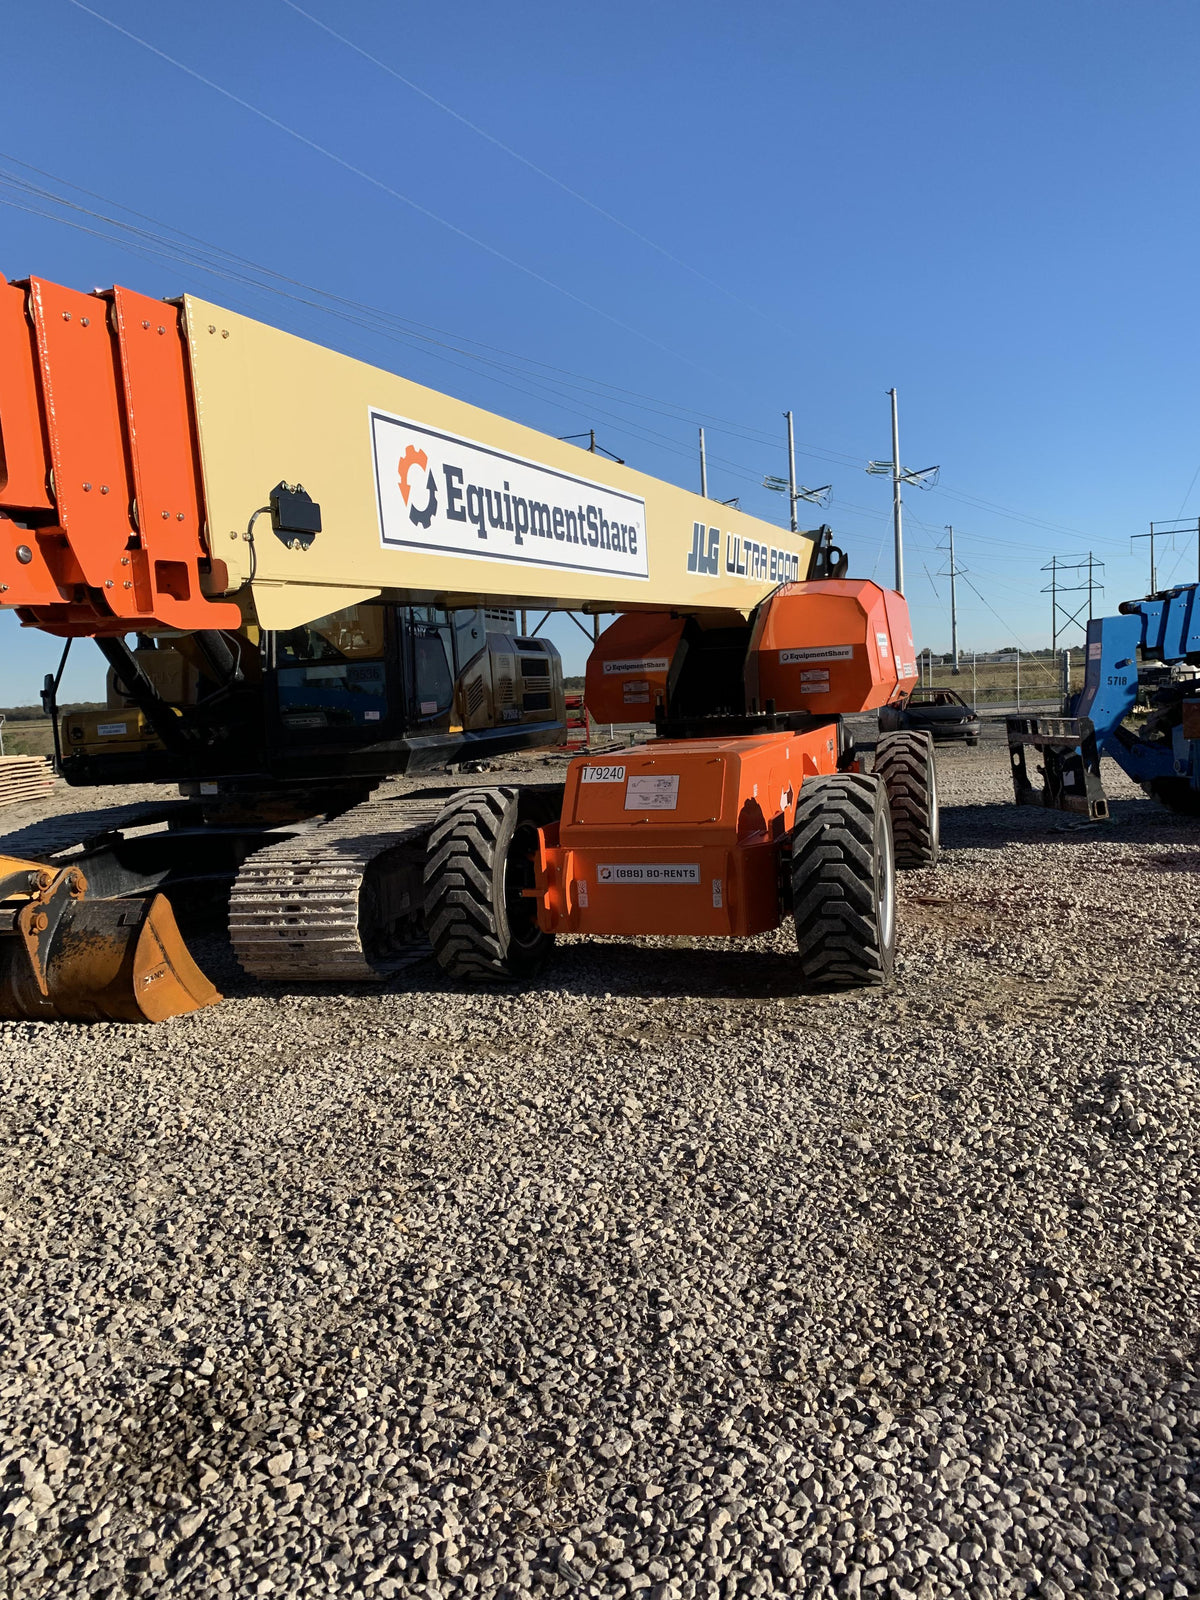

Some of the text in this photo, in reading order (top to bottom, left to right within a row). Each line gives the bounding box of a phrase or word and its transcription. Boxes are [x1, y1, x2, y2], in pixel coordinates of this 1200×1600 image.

[443, 463, 637, 555] EquipmentShare
[686, 521, 720, 577] JLG
[726, 533, 799, 584] ULTRA BOOM
[789, 649, 850, 660] EquipmentShare
[611, 661, 666, 671] EquipmentShare
[1107, 676, 1128, 686] 5718
[583, 766, 624, 780] 179240
[616, 869, 696, 878] (888) 80-RENTS
